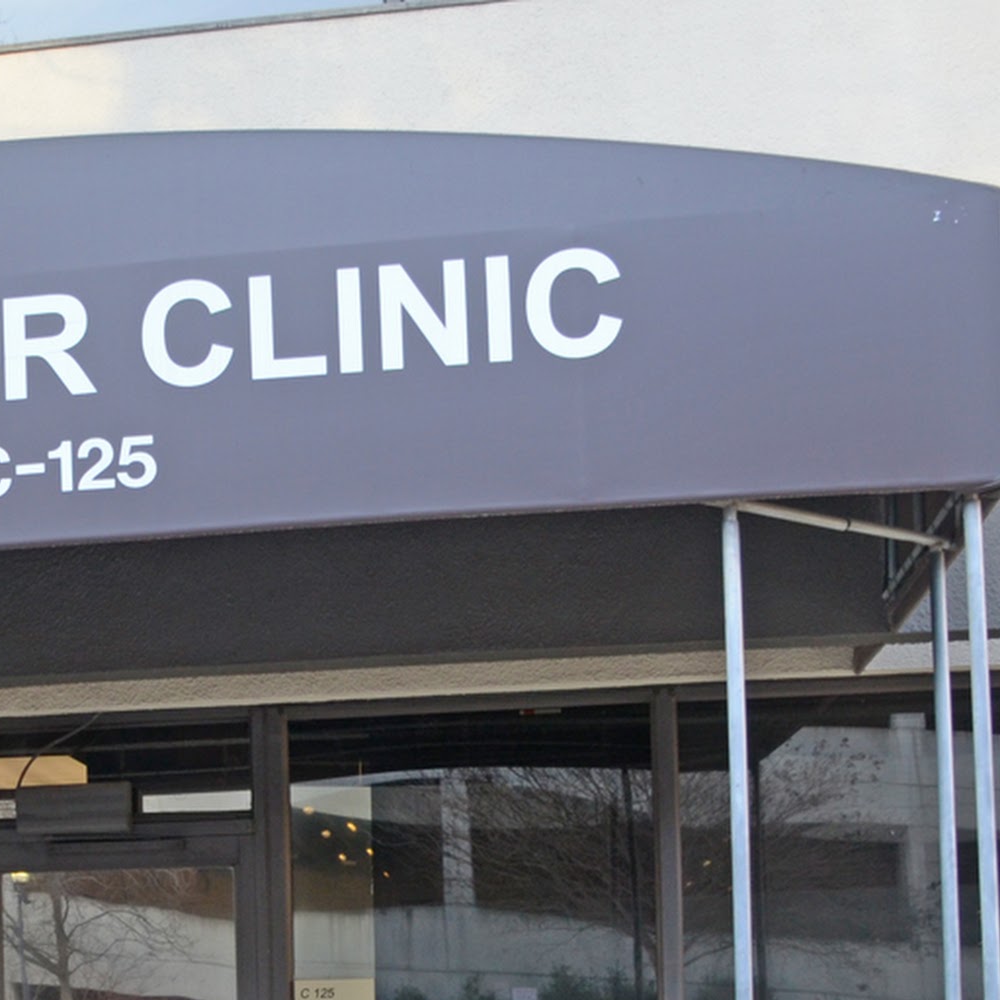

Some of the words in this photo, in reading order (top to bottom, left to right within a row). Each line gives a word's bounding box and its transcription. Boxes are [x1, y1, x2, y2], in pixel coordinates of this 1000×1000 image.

[141, 247, 623, 387] CLINIC
[300, 987, 311, 999] C
[314, 987, 335, 999] 125
